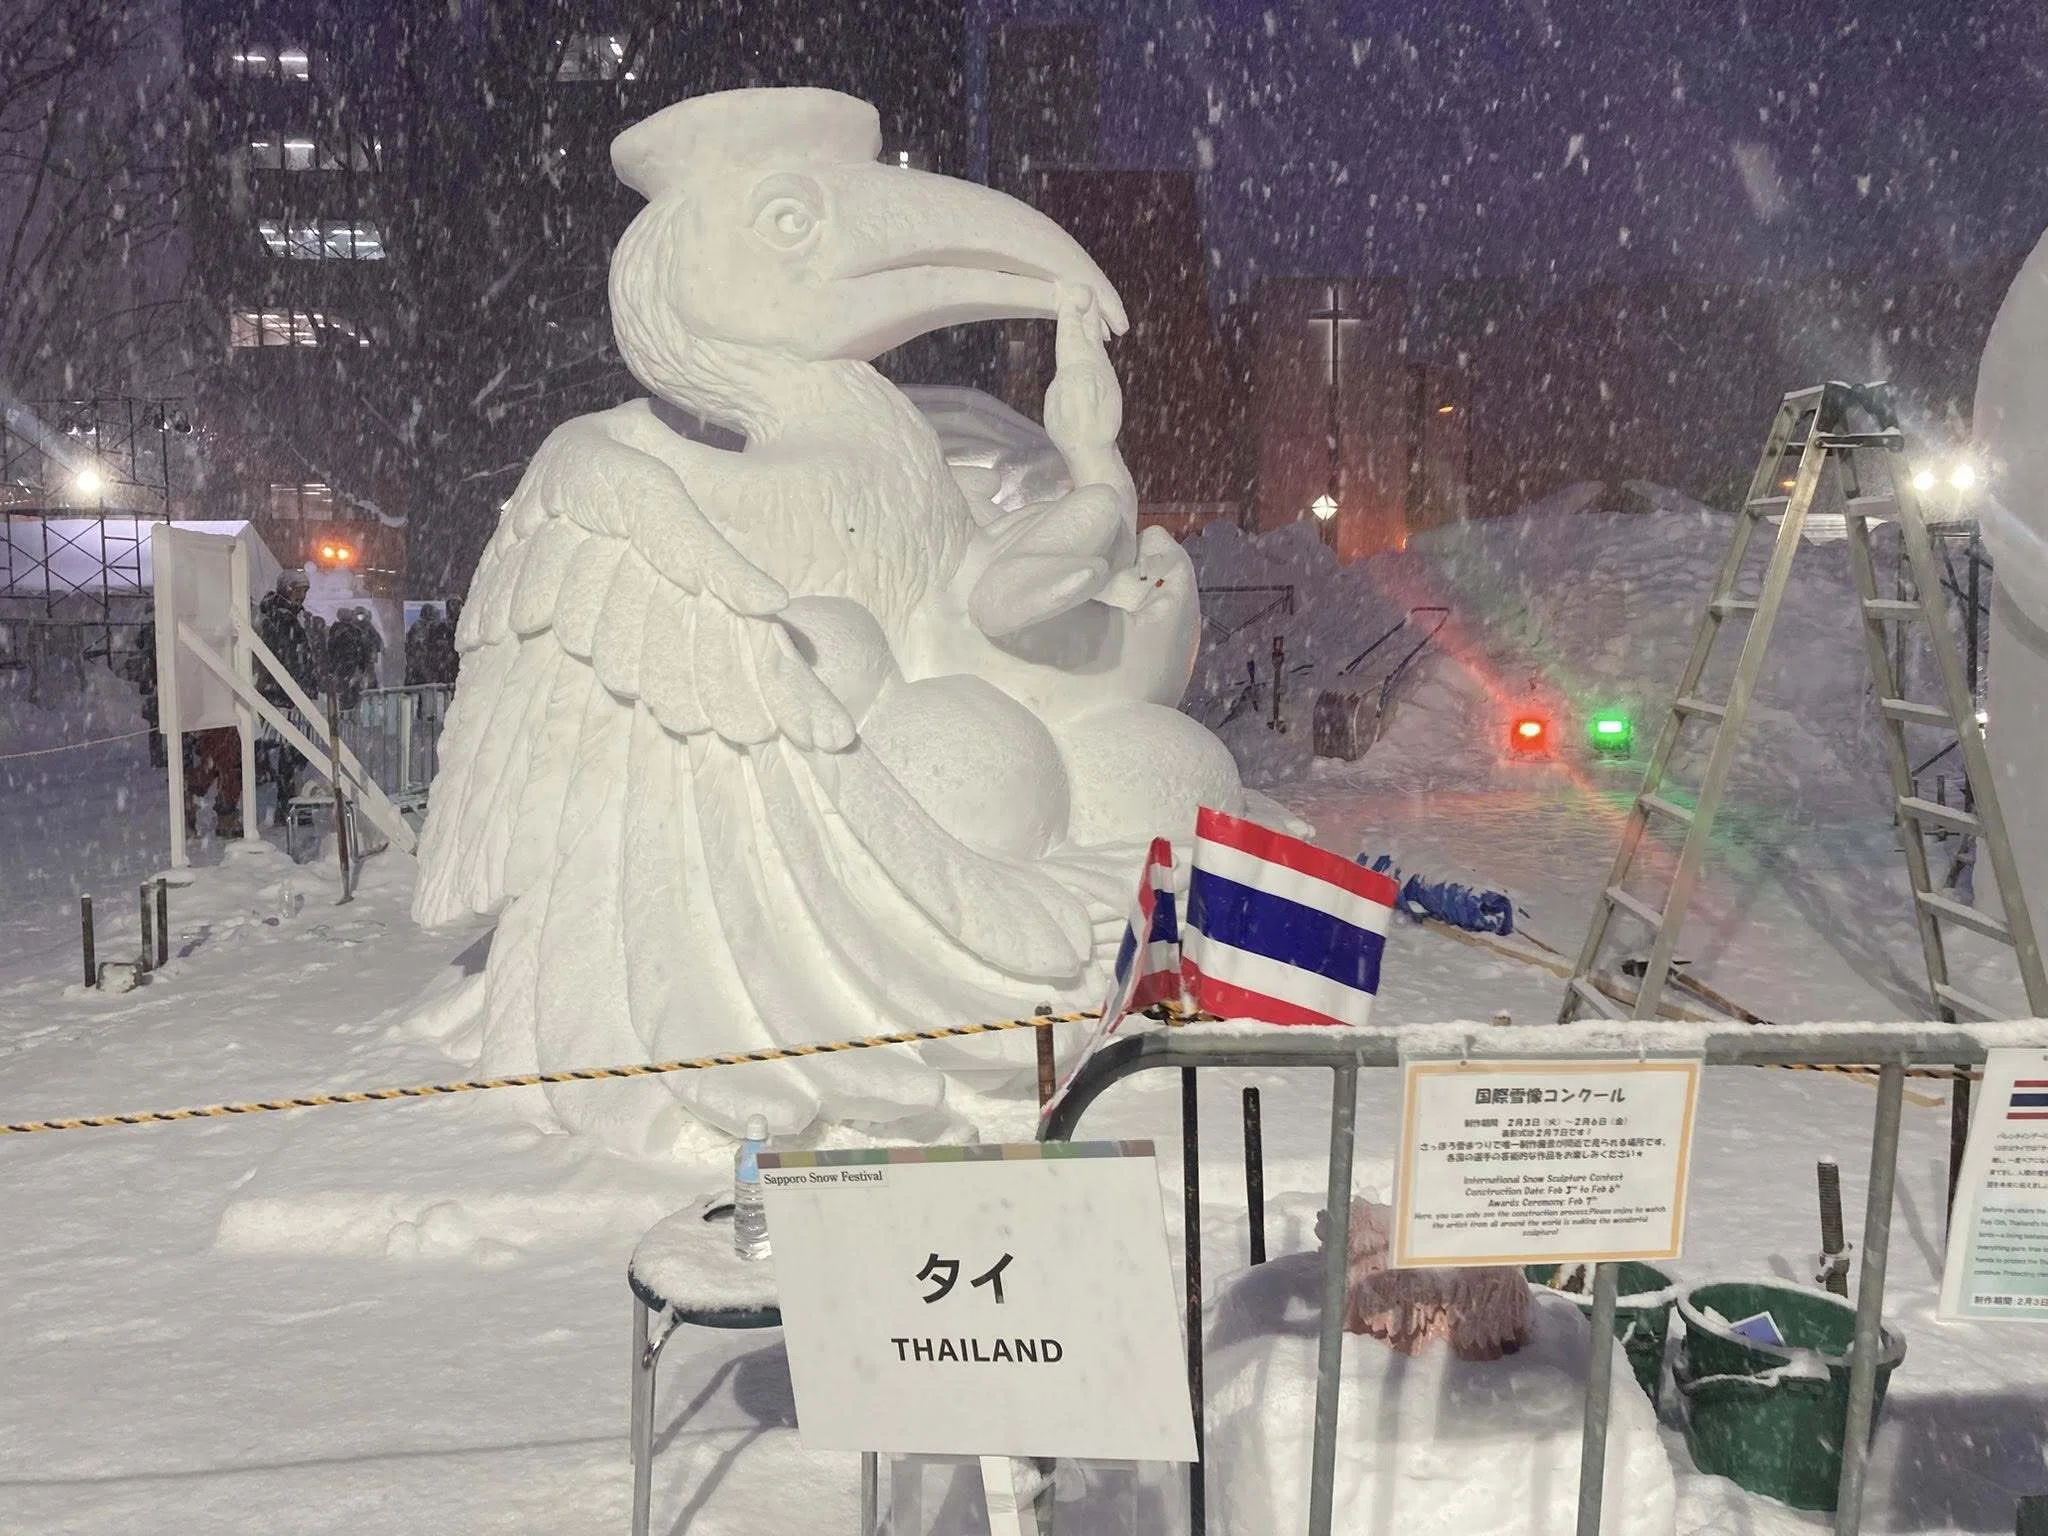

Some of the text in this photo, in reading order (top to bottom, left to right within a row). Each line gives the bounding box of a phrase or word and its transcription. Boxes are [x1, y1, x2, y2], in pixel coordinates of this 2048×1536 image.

[1475, 1087, 1626, 1105] 国際雪像コンクール
[763, 1169, 883, 1187] Sapporo Snow Festival
[1464, 1173, 1624, 1185] International Snow Sculpture Contest
[1465, 1187, 1522, 1197] Construction
[1547, 1186, 1563, 1195] Feb
[1580, 1184, 1589, 1193] to
[1592, 1184, 1606, 1193] Feb
[1488, 1199, 1520, 1208] Awards
[1568, 1196, 1583, 1206] Feb
[915, 1252, 1014, 1305] タイ
[891, 1337, 1064, 1364] THAILAND
